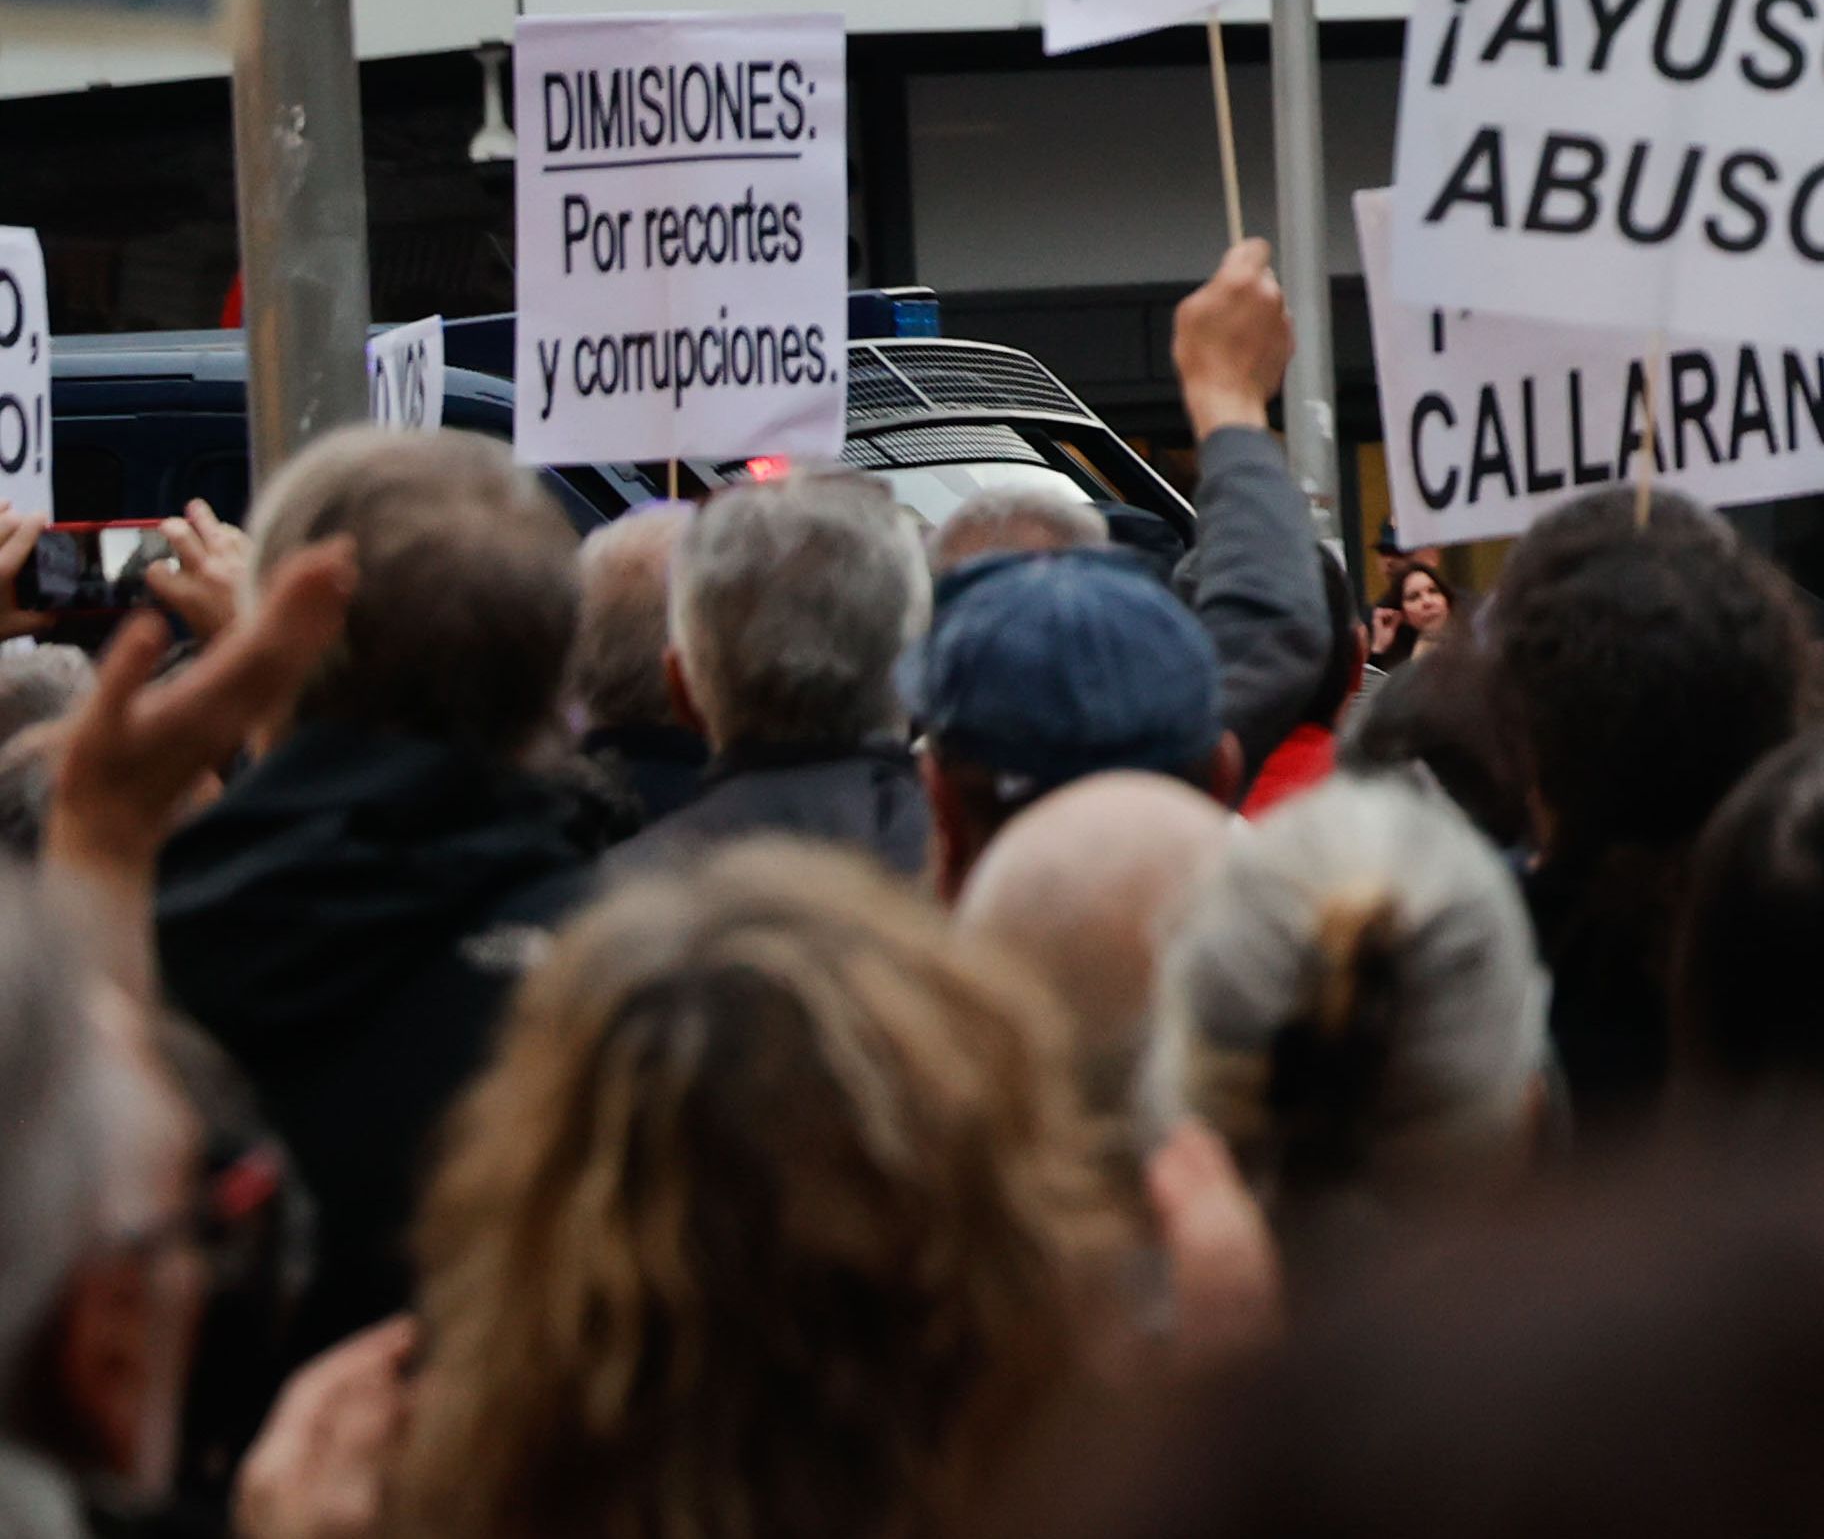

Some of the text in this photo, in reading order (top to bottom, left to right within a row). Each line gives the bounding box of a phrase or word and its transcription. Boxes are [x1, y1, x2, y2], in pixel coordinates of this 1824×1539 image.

[542, 60, 817, 153] DIMISIONES:
[563, 185, 804, 275] Por recortes
[537, 335, 561, 421] y
[573, 305, 839, 409] corrupciones.
